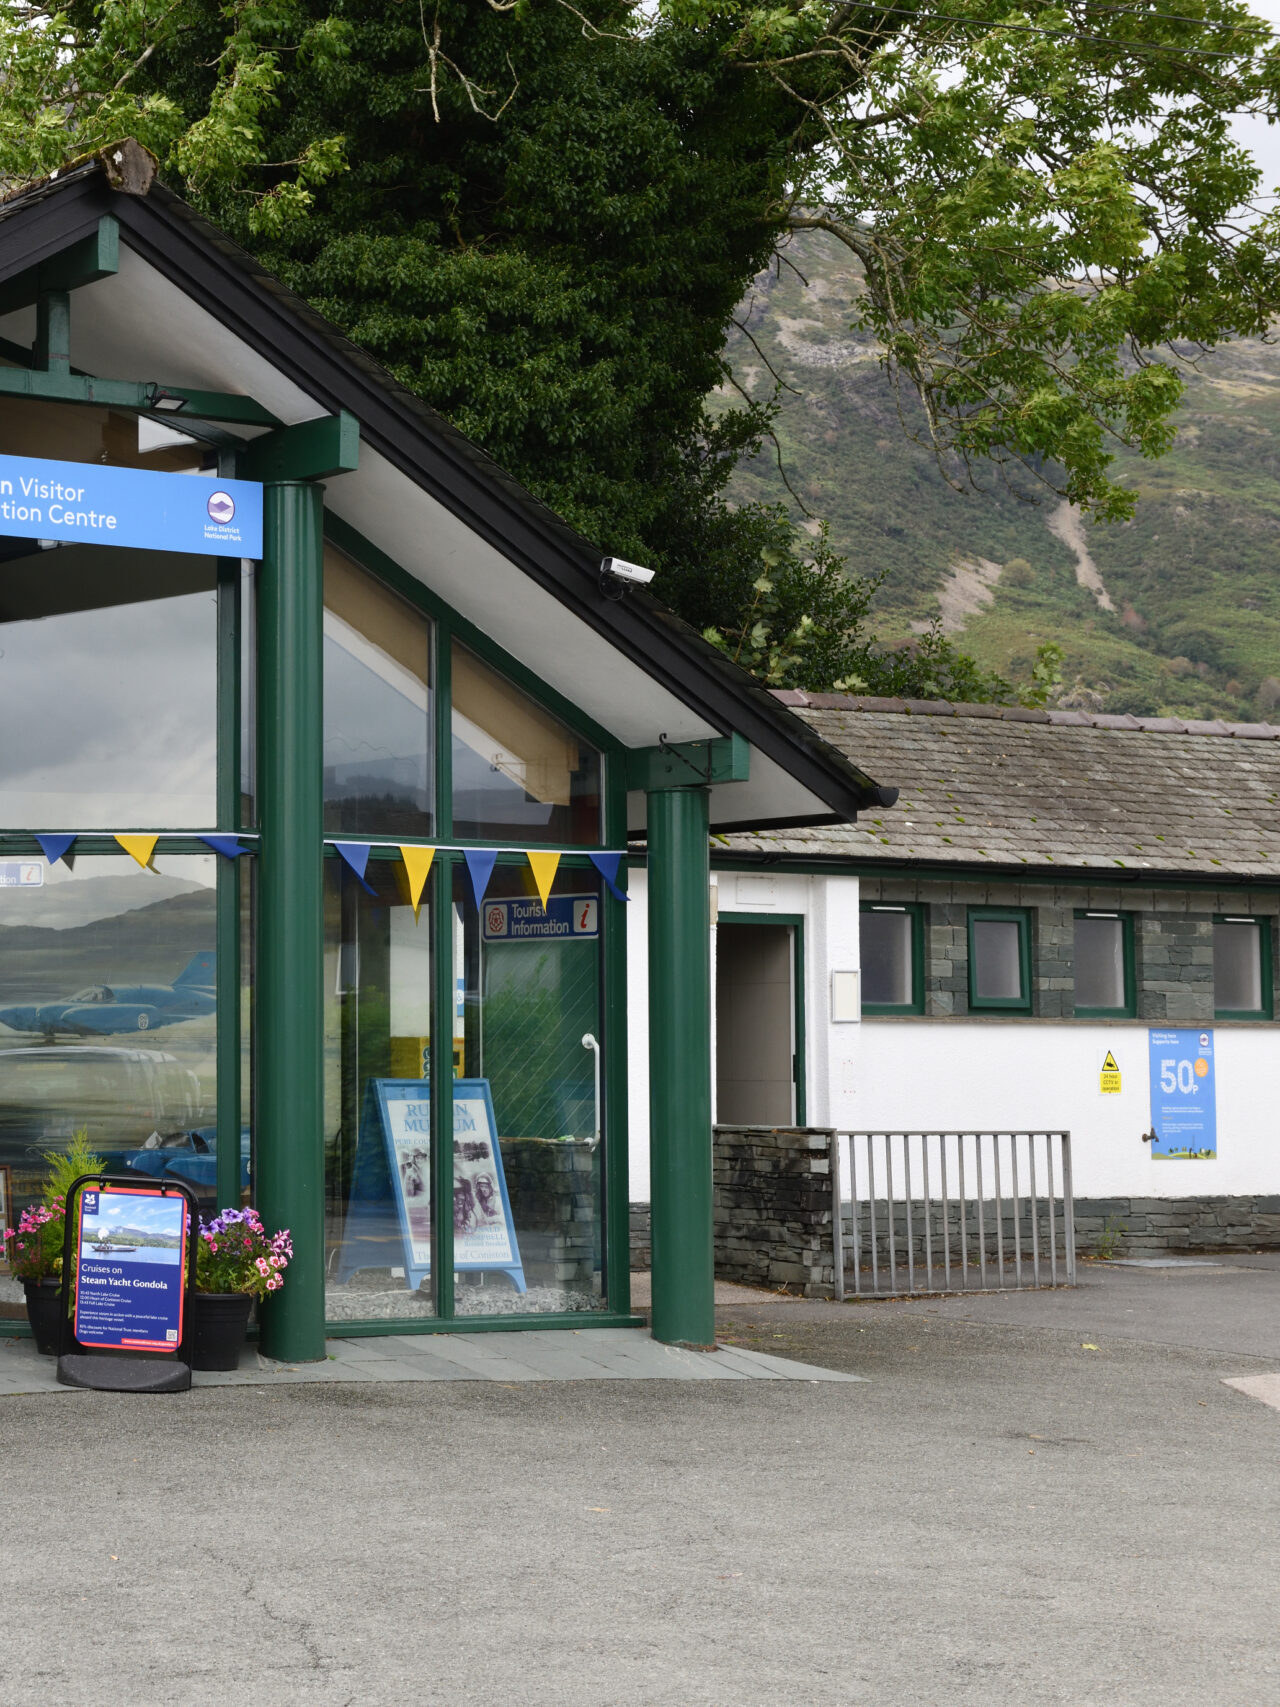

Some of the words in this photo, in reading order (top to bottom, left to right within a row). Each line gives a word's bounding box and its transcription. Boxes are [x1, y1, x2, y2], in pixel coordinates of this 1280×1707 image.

[19, 476, 85, 503] Visitor
[48, 505, 117, 530] Centre
[204, 532, 229, 540] National
[229, 534, 242, 542] Park
[219, 526, 240, 534] District
[511, 919, 569, 936] Information
[81, 1263, 110, 1274] Cruises
[111, 1267, 123, 1275] on
[81, 1275, 107, 1286] Steam
[108, 1277, 131, 1288] Yacht
[133, 1279, 168, 1291] Gondola
